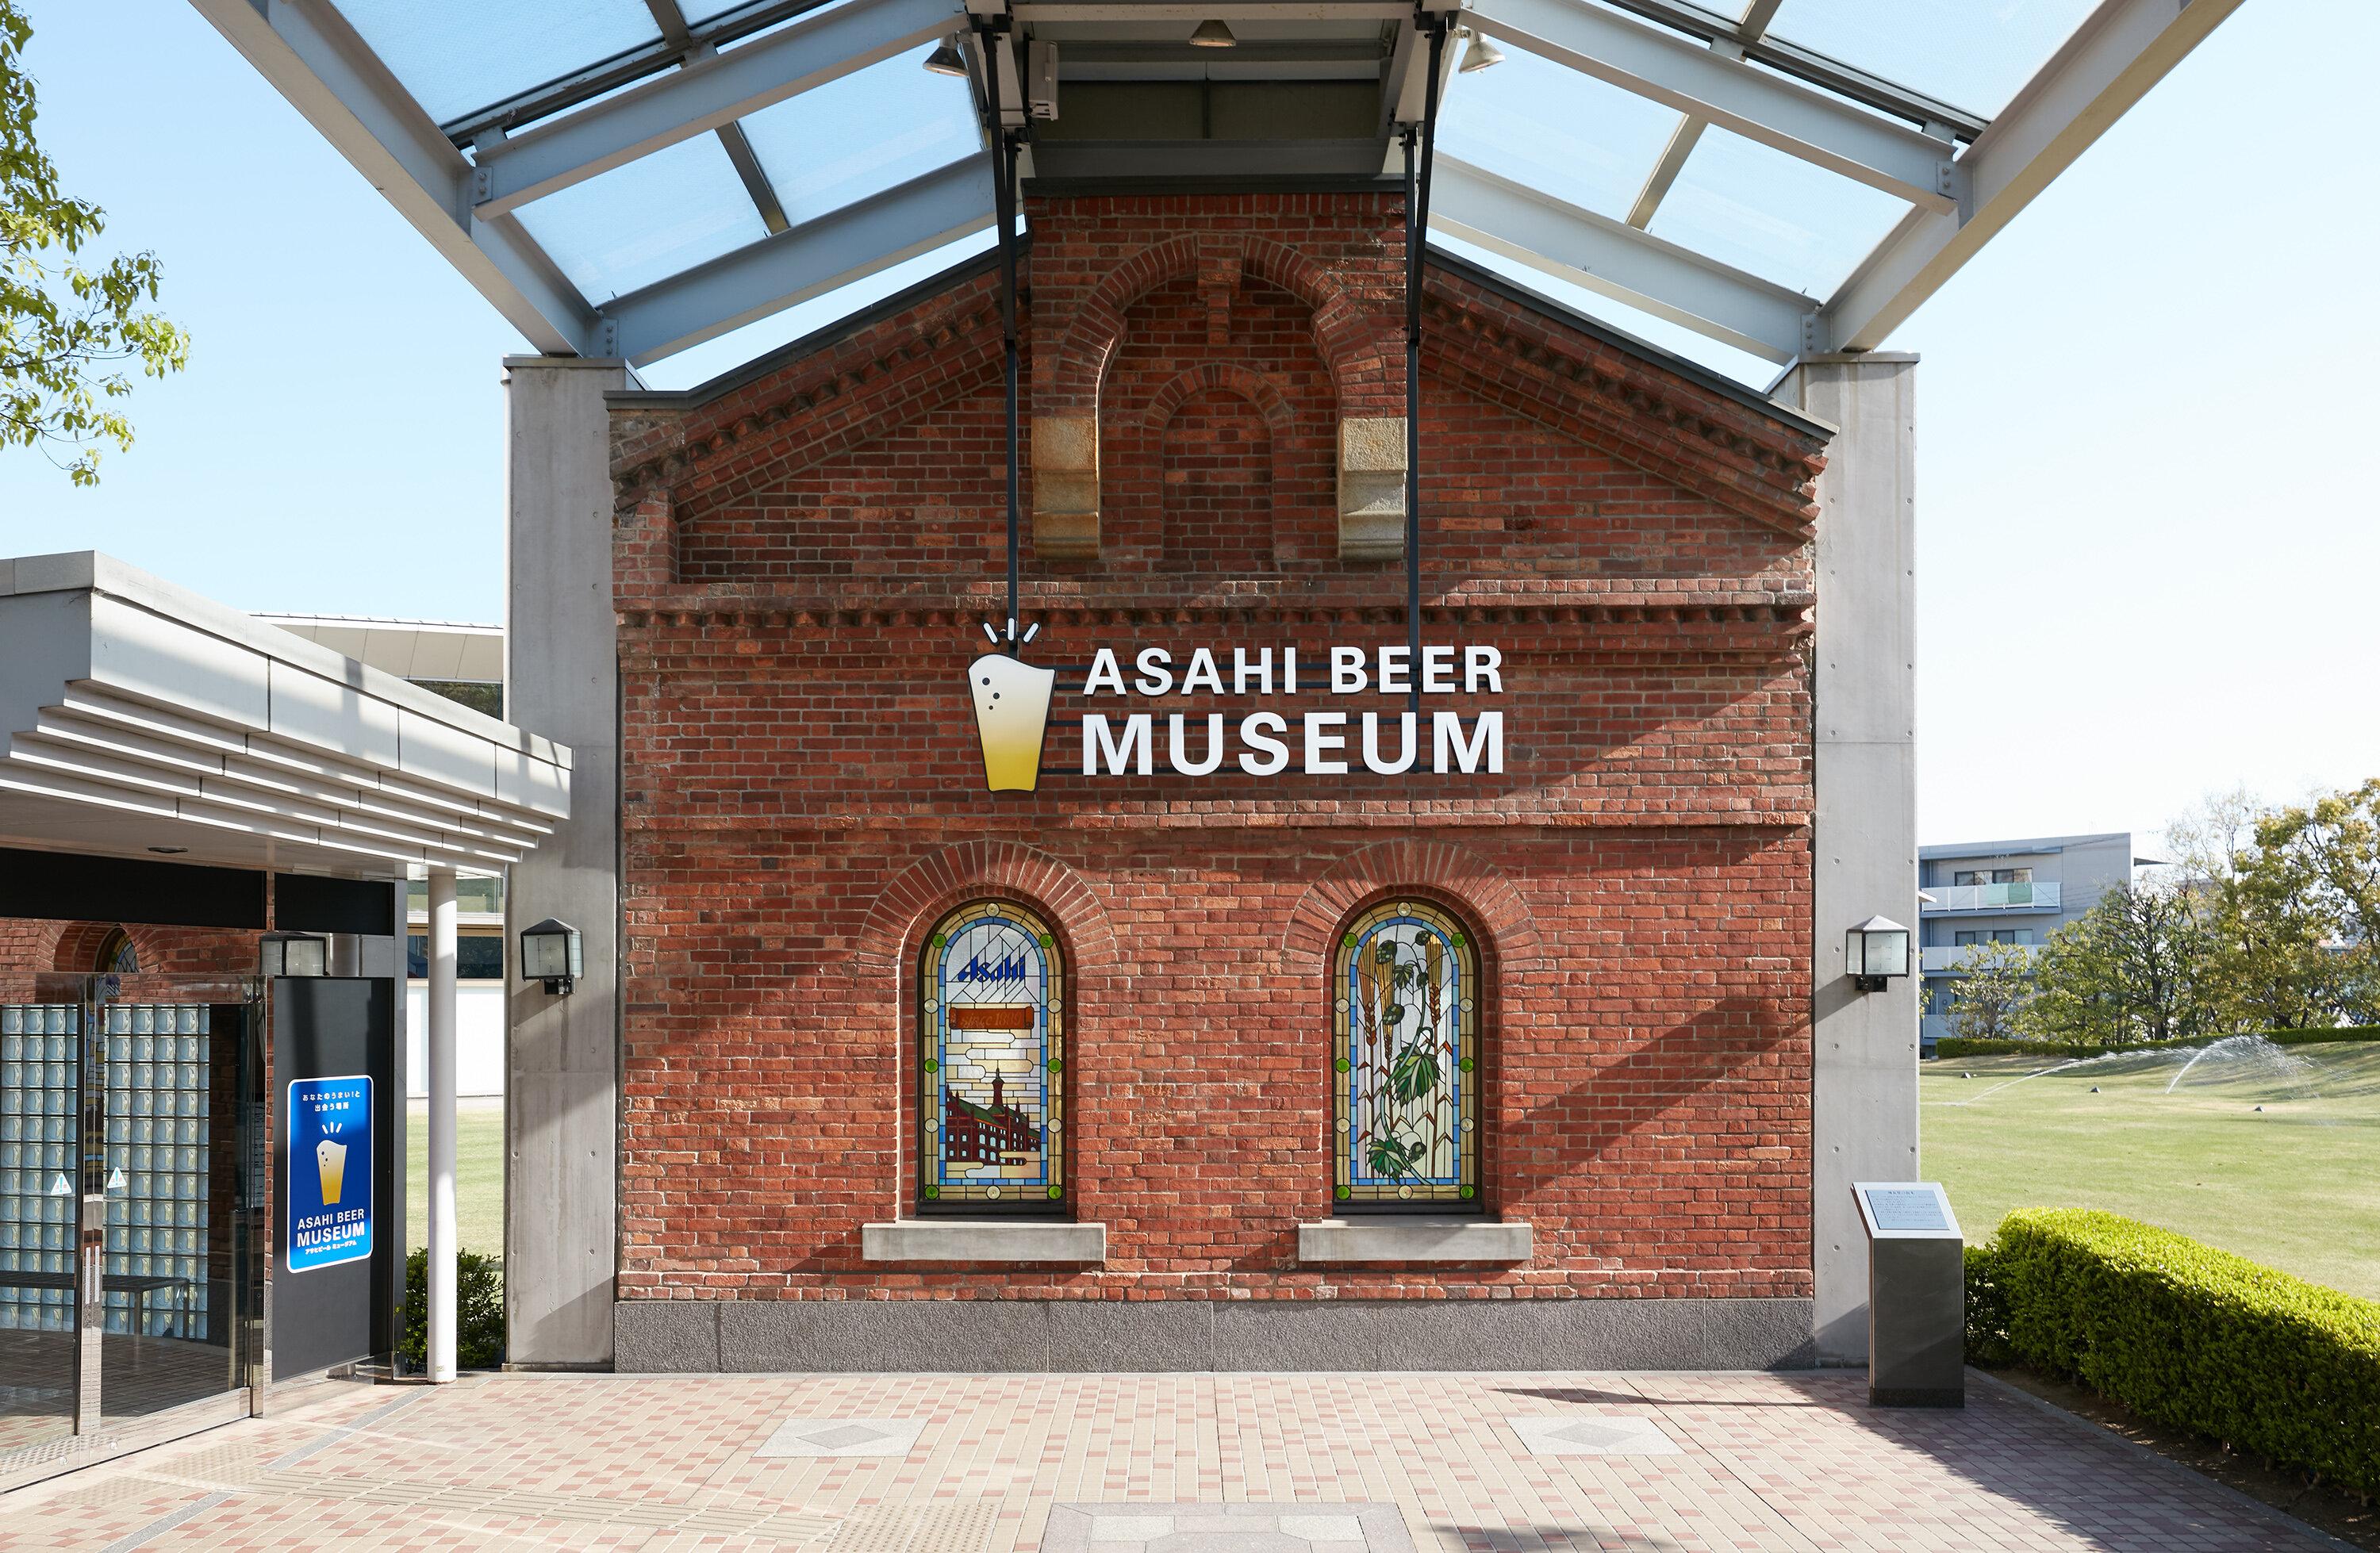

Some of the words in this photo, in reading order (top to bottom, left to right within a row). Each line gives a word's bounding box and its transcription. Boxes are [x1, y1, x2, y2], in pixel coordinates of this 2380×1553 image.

[1082, 646, 1296, 696] ASAHI
[1330, 645, 1503, 695] BEER
[1082, 711, 1504, 776] MUSEUM
[958, 954, 1026, 983] Asahi
[314, 1102, 349, 1112] 出会う場所
[298, 1214, 333, 1230] ASAHI
[337, 1208, 364, 1223] BEER
[297, 1221, 365, 1248] MUSEUM
